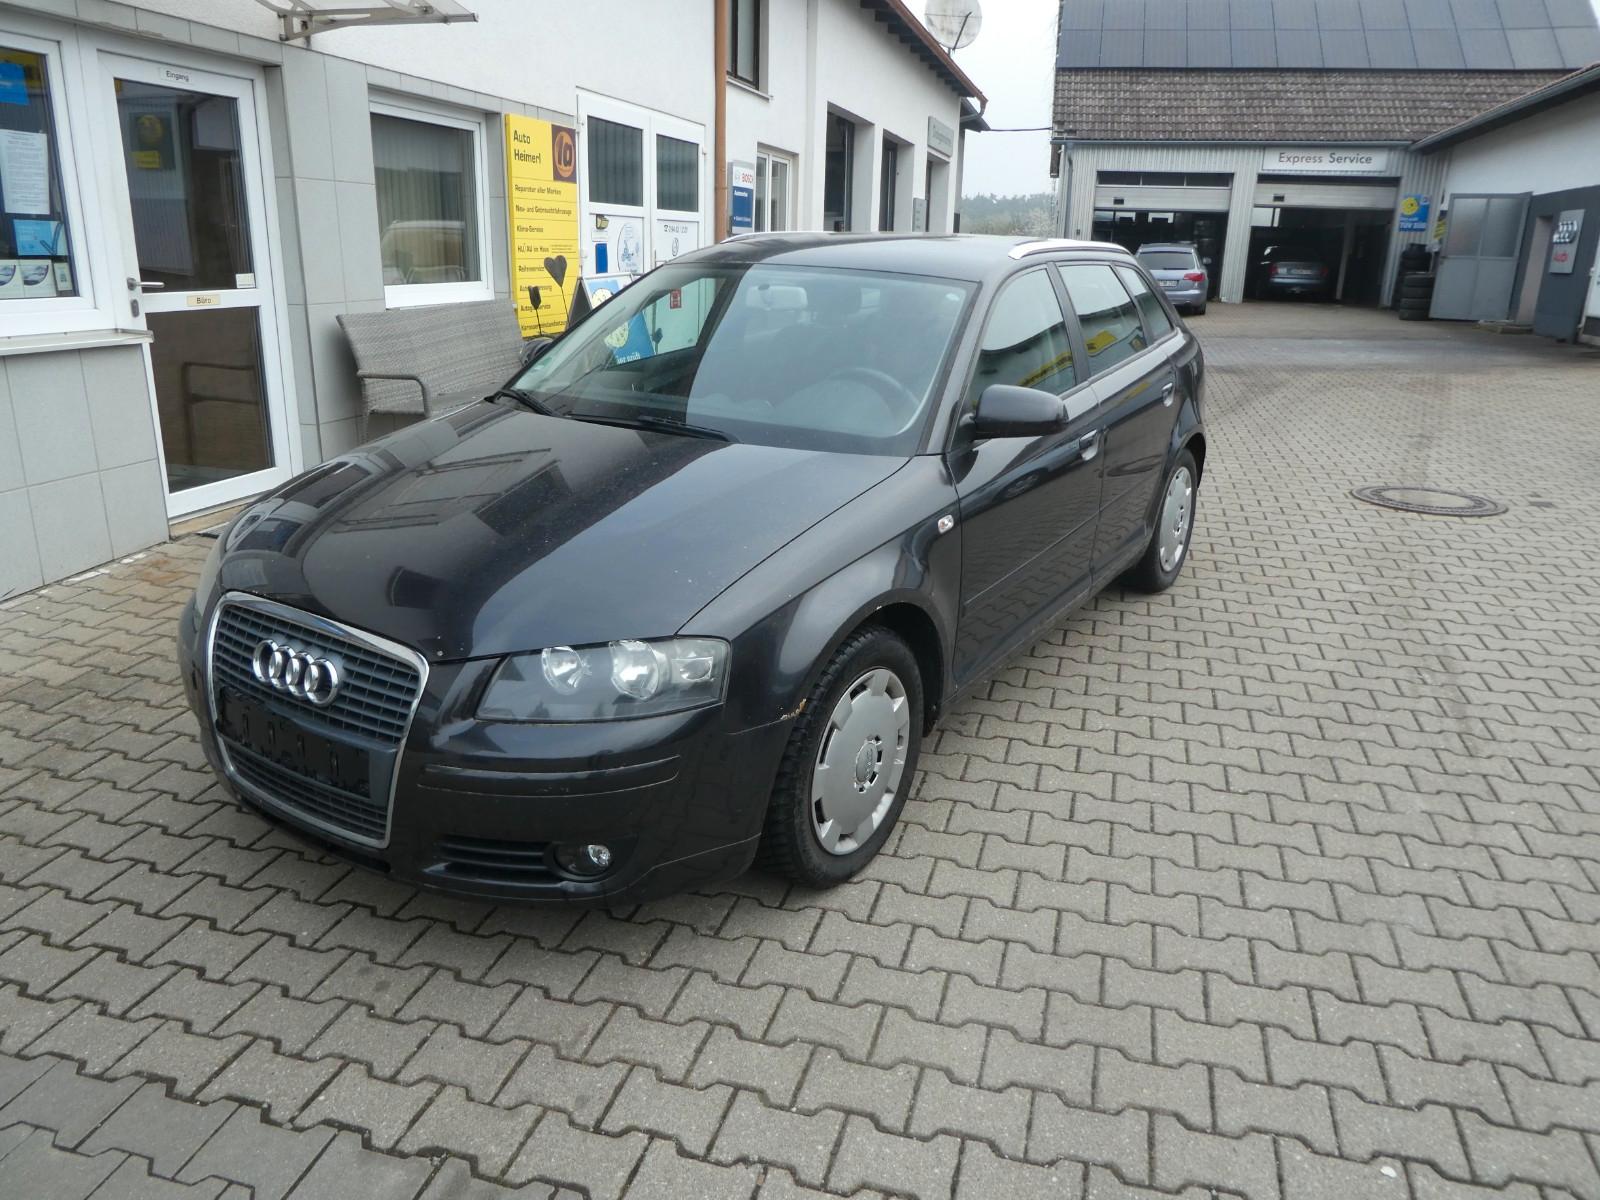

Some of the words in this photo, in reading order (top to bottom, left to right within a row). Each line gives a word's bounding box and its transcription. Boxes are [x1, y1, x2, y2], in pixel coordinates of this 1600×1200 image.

[166, 70, 189, 82] Eingang
[513, 130, 531, 144] Auto
[514, 148, 541, 164] Heimerl
[1279, 152, 1323, 165] Express
[1328, 152, 1373, 164] Service
[196, 295, 212, 304] Büro
